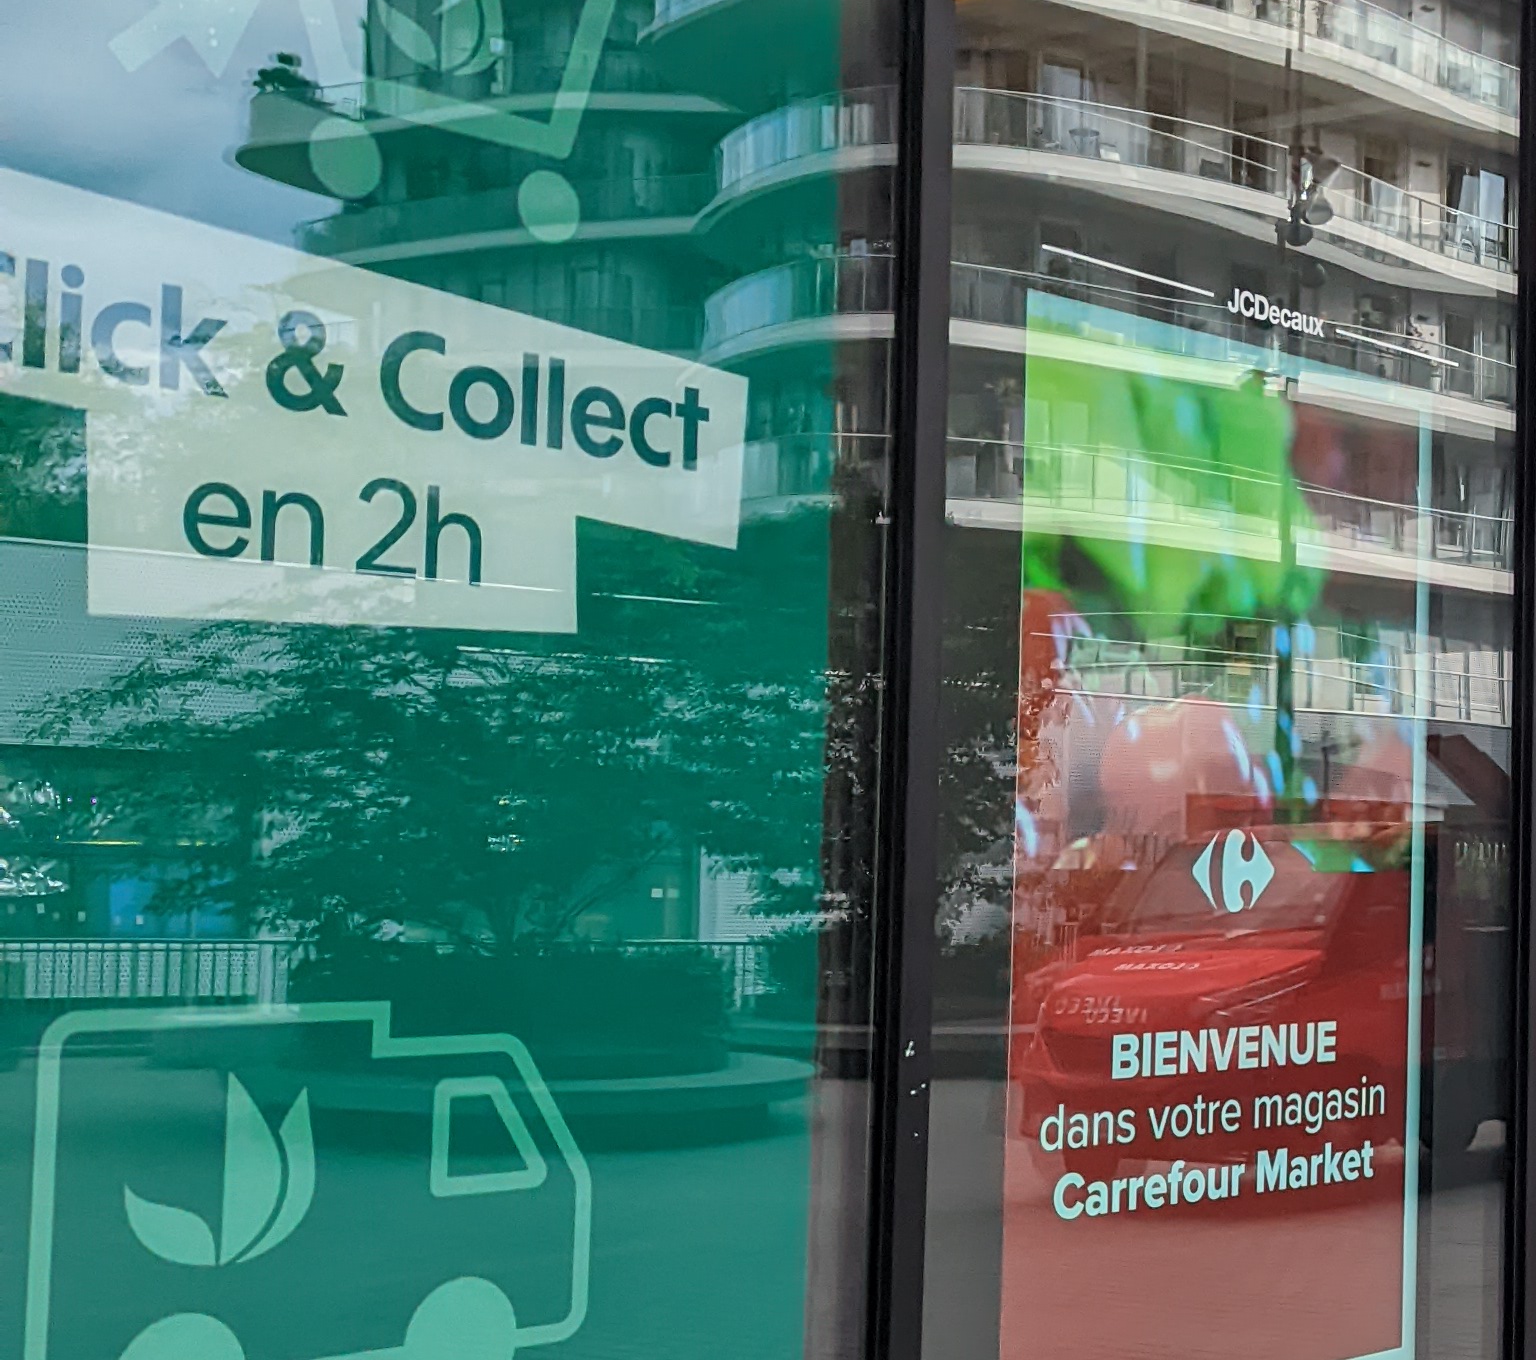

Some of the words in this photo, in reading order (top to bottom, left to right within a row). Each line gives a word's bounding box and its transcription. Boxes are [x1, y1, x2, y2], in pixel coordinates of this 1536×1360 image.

[1227, 287, 1325, 338] JCDecaux
[0, 251, 229, 398] lick
[265, 309, 349, 418] &
[379, 329, 710, 472] Collect
[182, 479, 326, 568] en
[354, 476, 484, 587] 2h
[1111, 1020, 1338, 1080] BIENVENUE
[1040, 1103, 1136, 1152] dans
[1148, 1093, 1240, 1140] votre
[1253, 1076, 1387, 1135] magasin
[1053, 1159, 1246, 1221] Carrefour
[1255, 1140, 1375, 1194] Market
